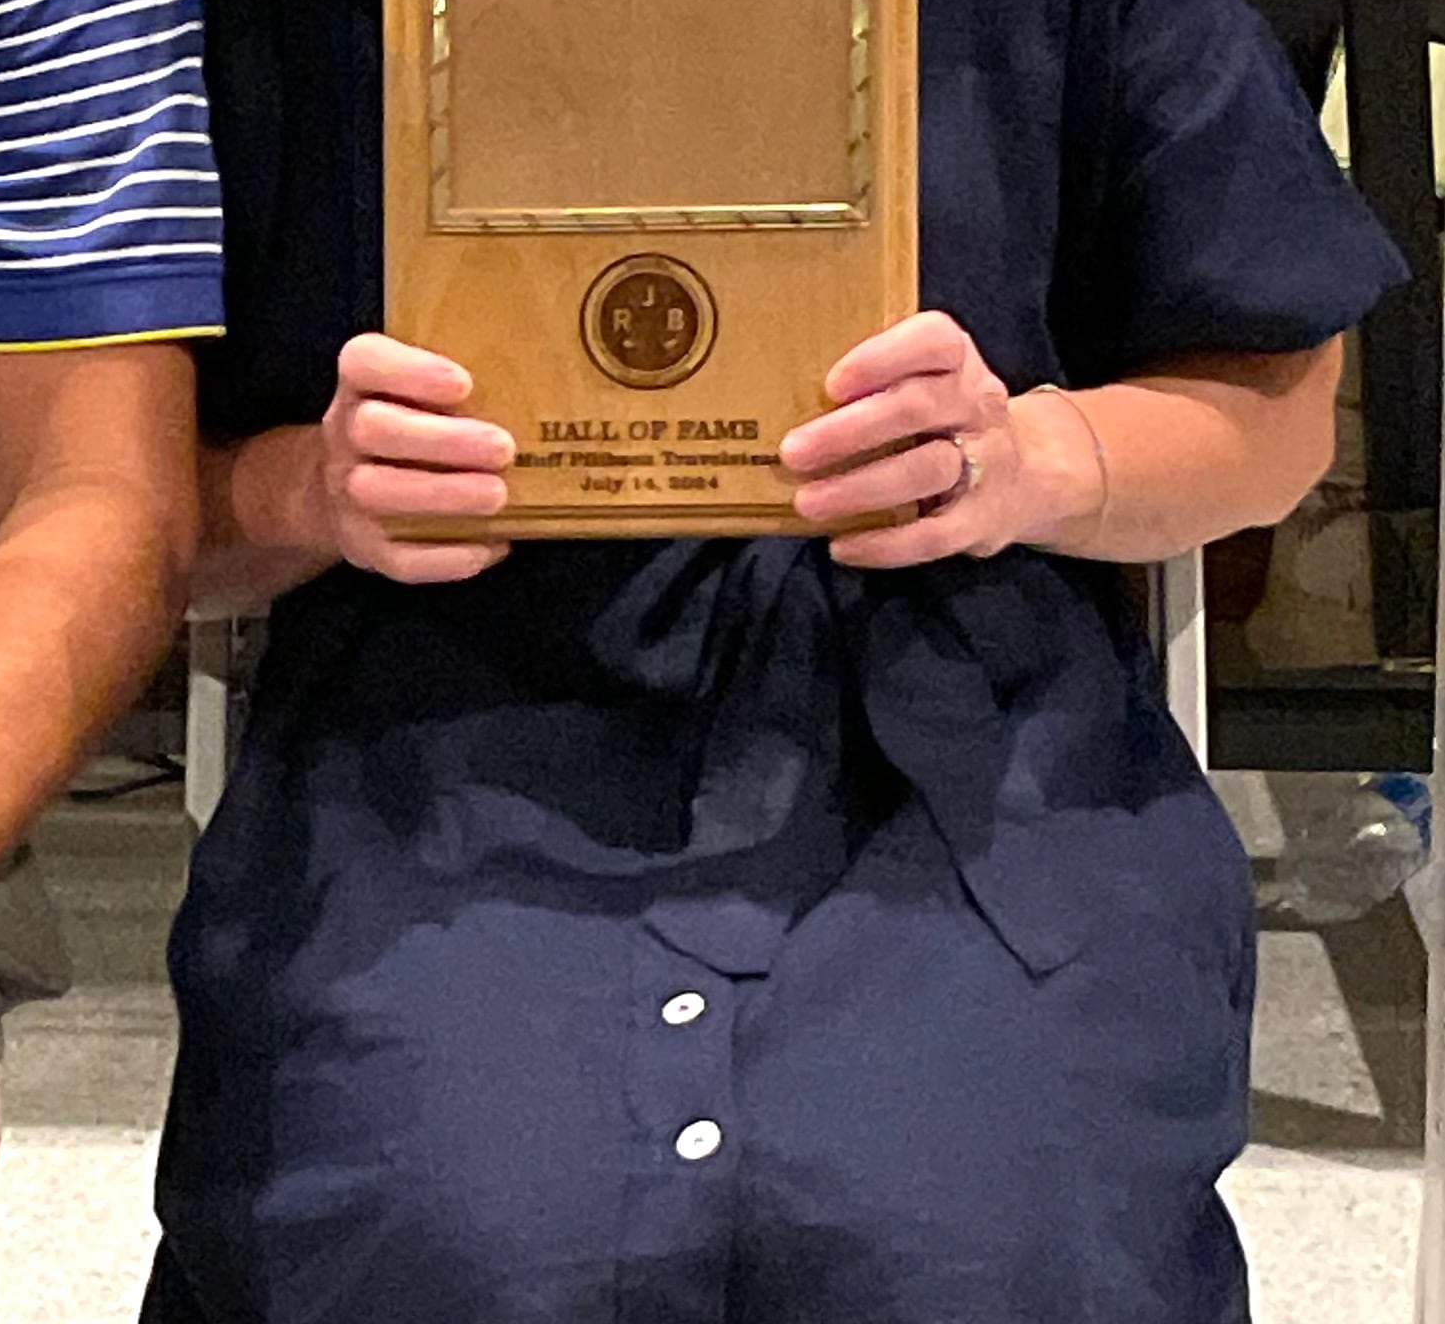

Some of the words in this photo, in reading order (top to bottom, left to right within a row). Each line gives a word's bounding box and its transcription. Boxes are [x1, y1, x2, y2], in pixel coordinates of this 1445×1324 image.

[643, 284, 655, 308] J
[612, 307, 633, 334] R
[666, 308, 684, 332] B
[539, 420, 620, 443] HALL
[628, 420, 667, 441] OF
[676, 420, 759, 441] FAME
[580, 476, 625, 494] July
[668, 475, 719, 490] 2024
